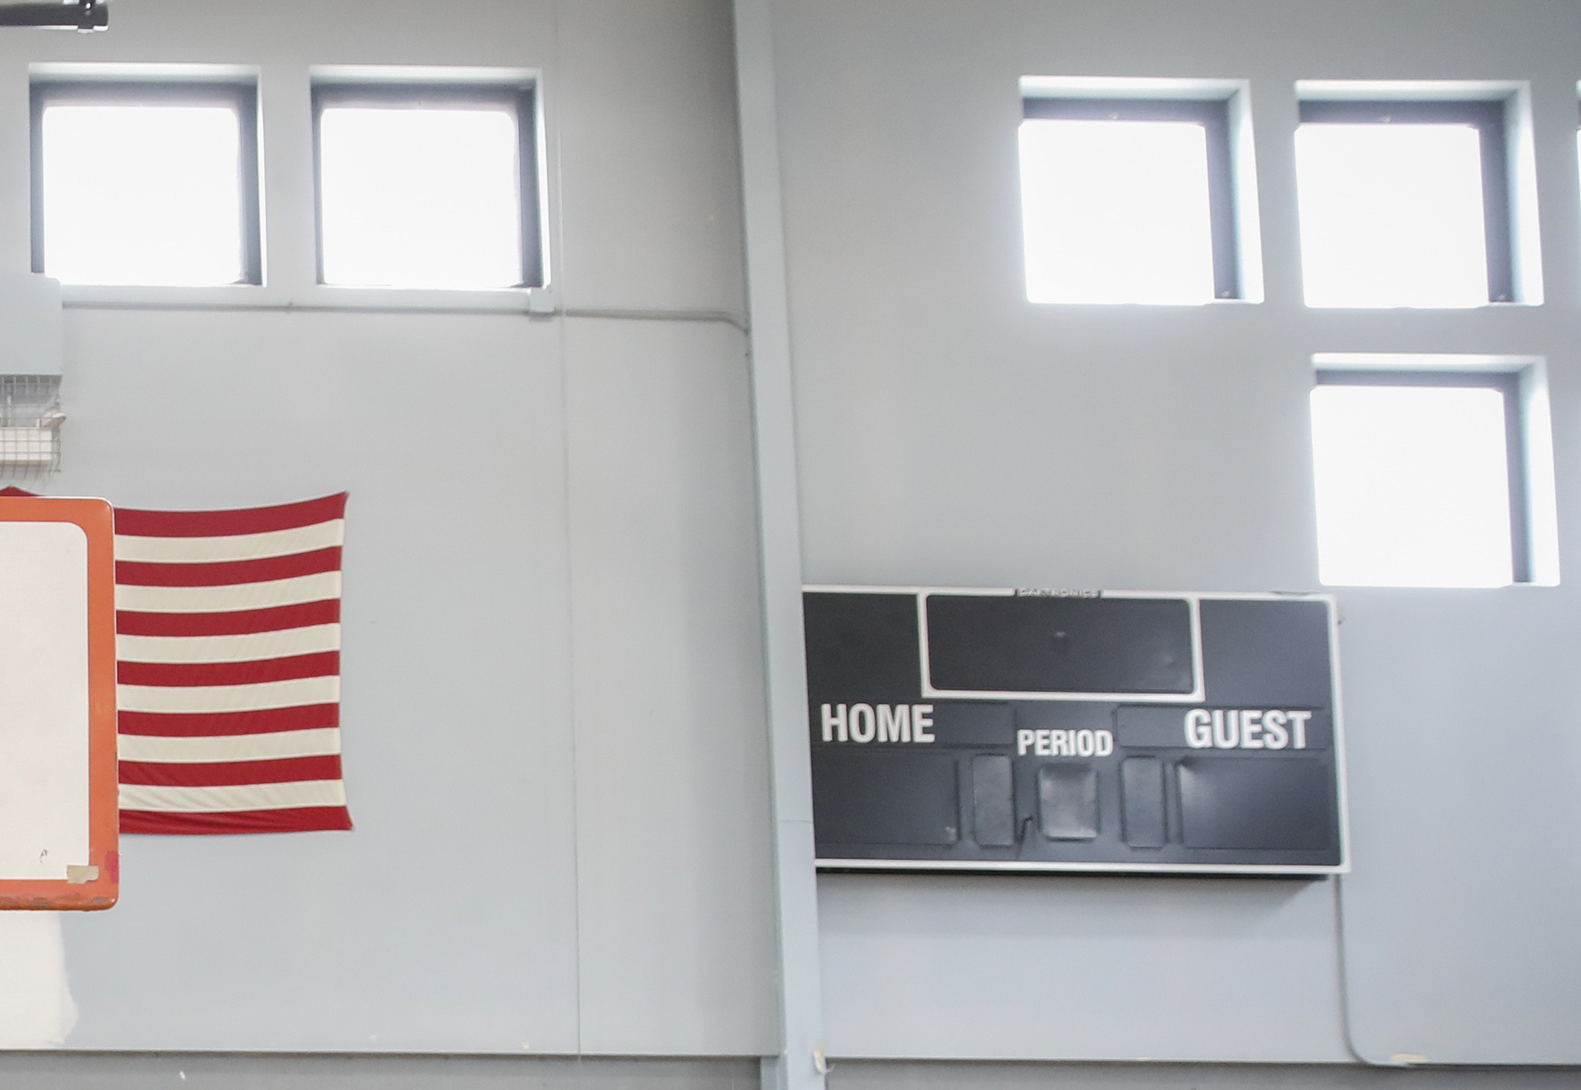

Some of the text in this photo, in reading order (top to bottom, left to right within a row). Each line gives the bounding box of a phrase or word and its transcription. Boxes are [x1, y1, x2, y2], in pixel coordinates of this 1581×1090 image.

[821, 703, 935, 743] HOME
[1017, 729, 1114, 757] PERIOD
[1184, 708, 1312, 750] GUEST
